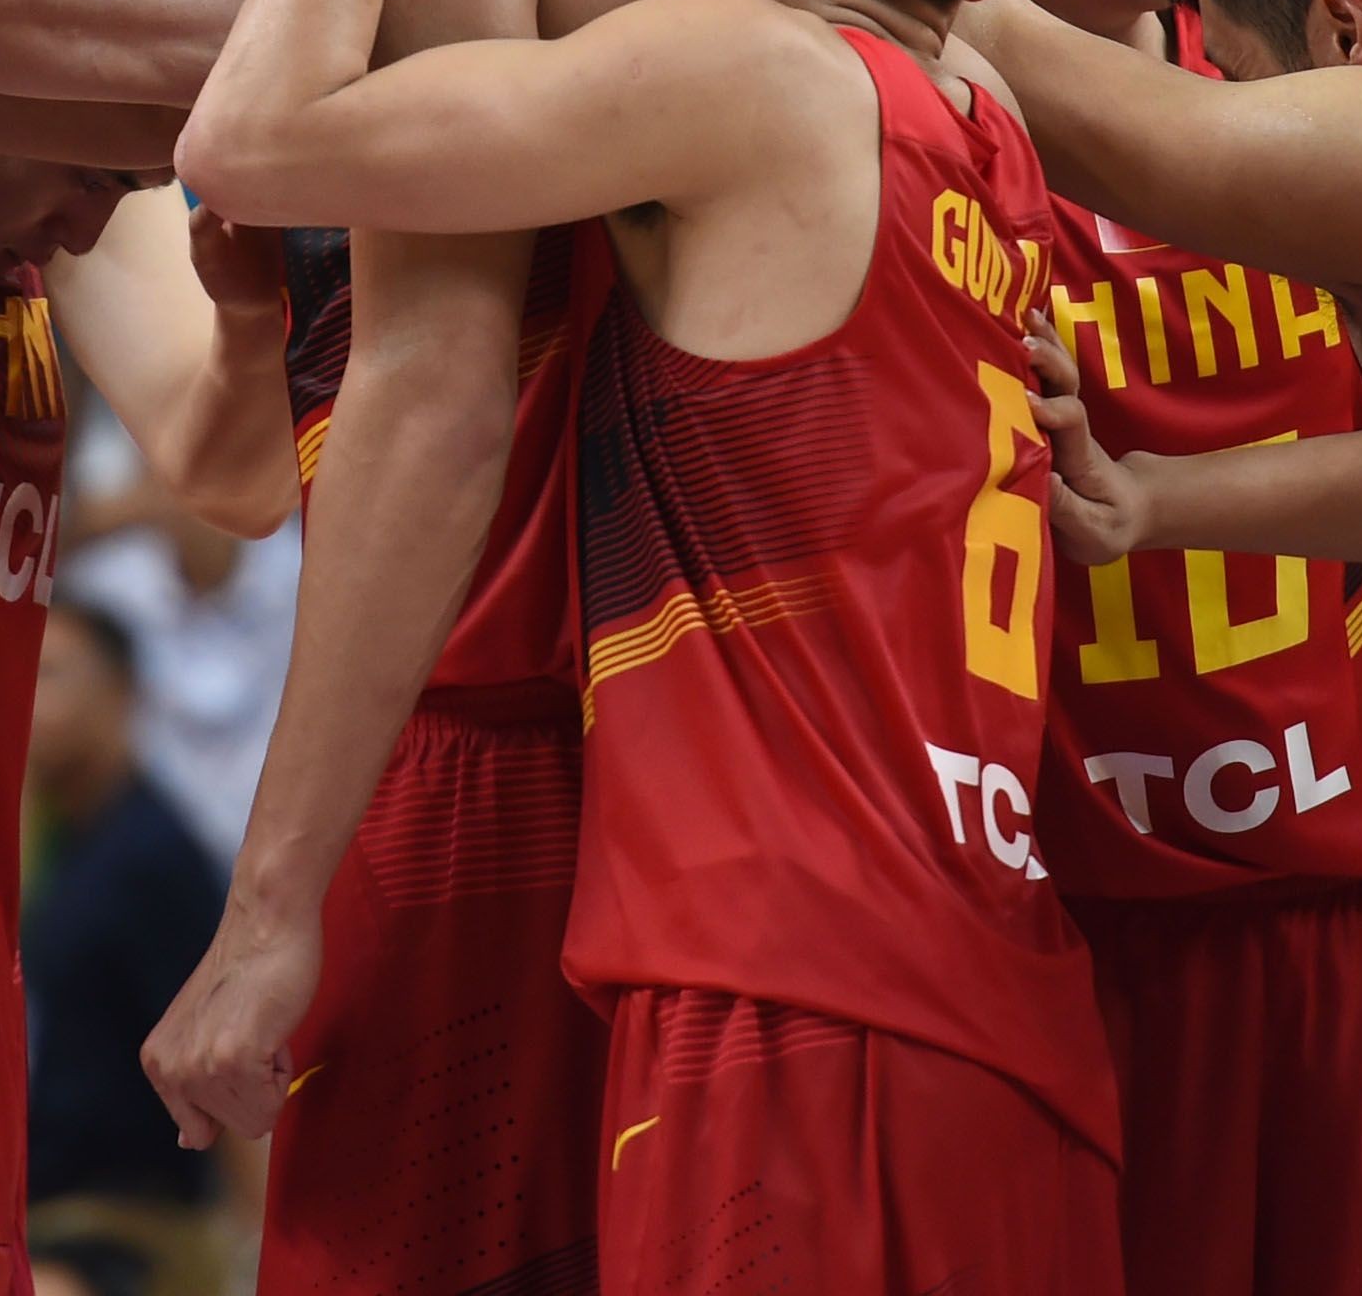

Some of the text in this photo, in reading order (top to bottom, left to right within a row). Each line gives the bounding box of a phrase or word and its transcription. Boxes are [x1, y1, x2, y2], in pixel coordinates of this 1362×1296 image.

[932, 188, 1012, 316] GUO
[1050, 263, 1341, 389] HINA
[962, 360, 1045, 700] 6
[1085, 721, 1352, 835] TCL
